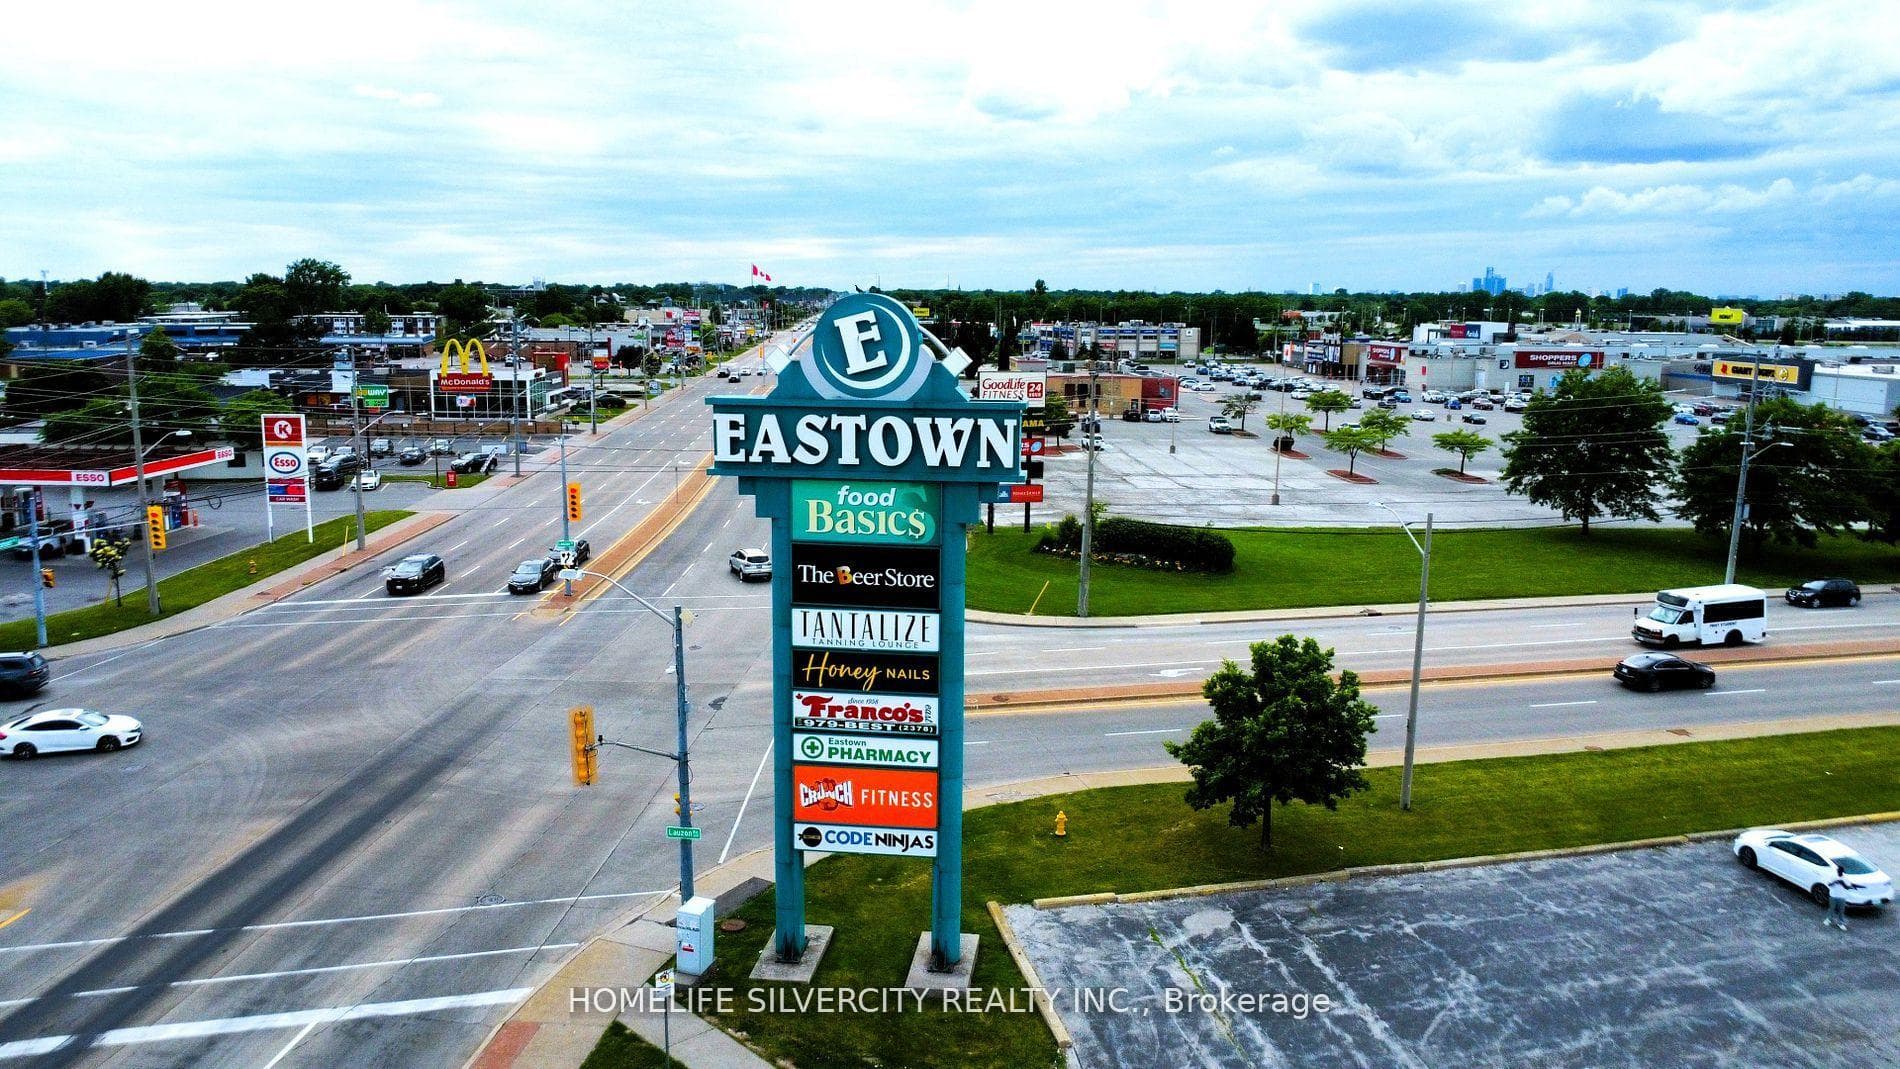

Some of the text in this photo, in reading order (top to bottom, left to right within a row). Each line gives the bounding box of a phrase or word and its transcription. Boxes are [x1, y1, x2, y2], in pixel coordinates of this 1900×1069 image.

[834, 310, 888, 375] E
[982, 378, 1042, 392] GoodLife 24
[982, 390, 1024, 399] FITNESS
[278, 424, 289, 435] K
[713, 413, 1017, 468] EASTOWN
[76, 473, 105, 482] ESSO
[837, 485, 896, 507] food
[798, 564, 935, 588] The Beer Store
[801, 610, 931, 643] TANTALIZE
[812, 637, 919, 649] TANNING LOUNGE
[802, 651, 930, 692] Honey NAILS
[801, 695, 924, 723] Franco's
[804, 719, 896, 731] 979-BEST
[828, 737, 867, 747] Eastown
[828, 746, 931, 764] PHARMACY
[800, 780, 933, 808] CRUNCH FITNESS
[668, 828, 693, 837] Lauzon
[824, 829, 934, 853] CODE NINJAS
